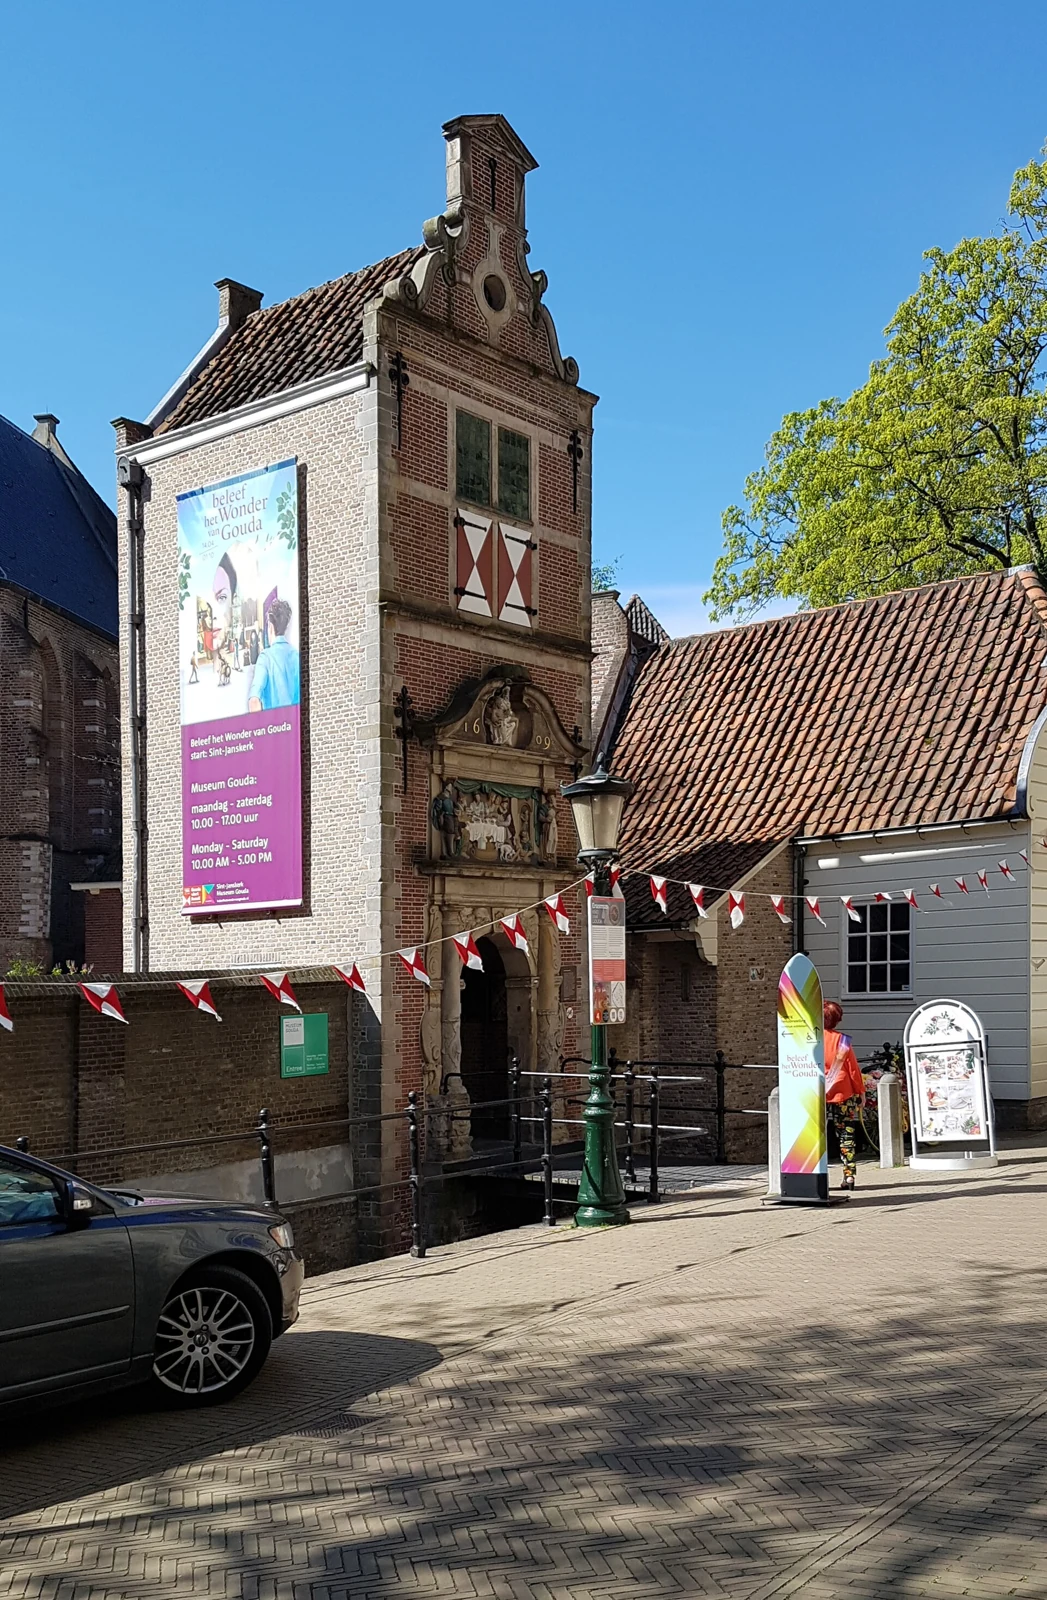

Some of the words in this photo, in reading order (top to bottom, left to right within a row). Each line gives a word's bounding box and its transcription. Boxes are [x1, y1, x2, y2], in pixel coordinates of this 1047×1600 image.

[212, 483, 247, 508] beleef
[204, 516, 218, 528] het
[218, 496, 268, 522] Wonder
[208, 528, 220, 537] van
[221, 516, 263, 540] Gouda
[190, 735, 211, 748] Beleef
[212, 734, 224, 744] het
[224, 729, 252, 742] Wonder
[253, 727, 266, 737] van
[267, 721, 292, 734] Gouda
[464, 718, 480, 734] 16
[190, 750, 208, 760] start:
[208, 741, 254, 757] Sint-Janskerk
[535, 735, 551, 750] 09
[190, 780, 226, 794] Museum
[227, 774, 257, 788] Gouda:
[191, 800, 229, 814] maandag
[236, 793, 273, 808] zaterdag
[191, 817, 213, 830] 10.00
[221, 813, 242, 826] 17.00
[243, 813, 259, 823] uur
[191, 841, 224, 855] Monday
[231, 836, 269, 850] Saturday
[191, 858, 214, 870] 10.00
[215, 856, 230, 868] AM
[237, 853, 256, 866] 5.00
[258, 851, 272, 863] PM
[216, 889, 235, 897] Museum
[786, 1054, 808, 1062] beleef
[790, 1061, 820, 1069] Wonder
[792, 1069, 818, 1077] Gouda
